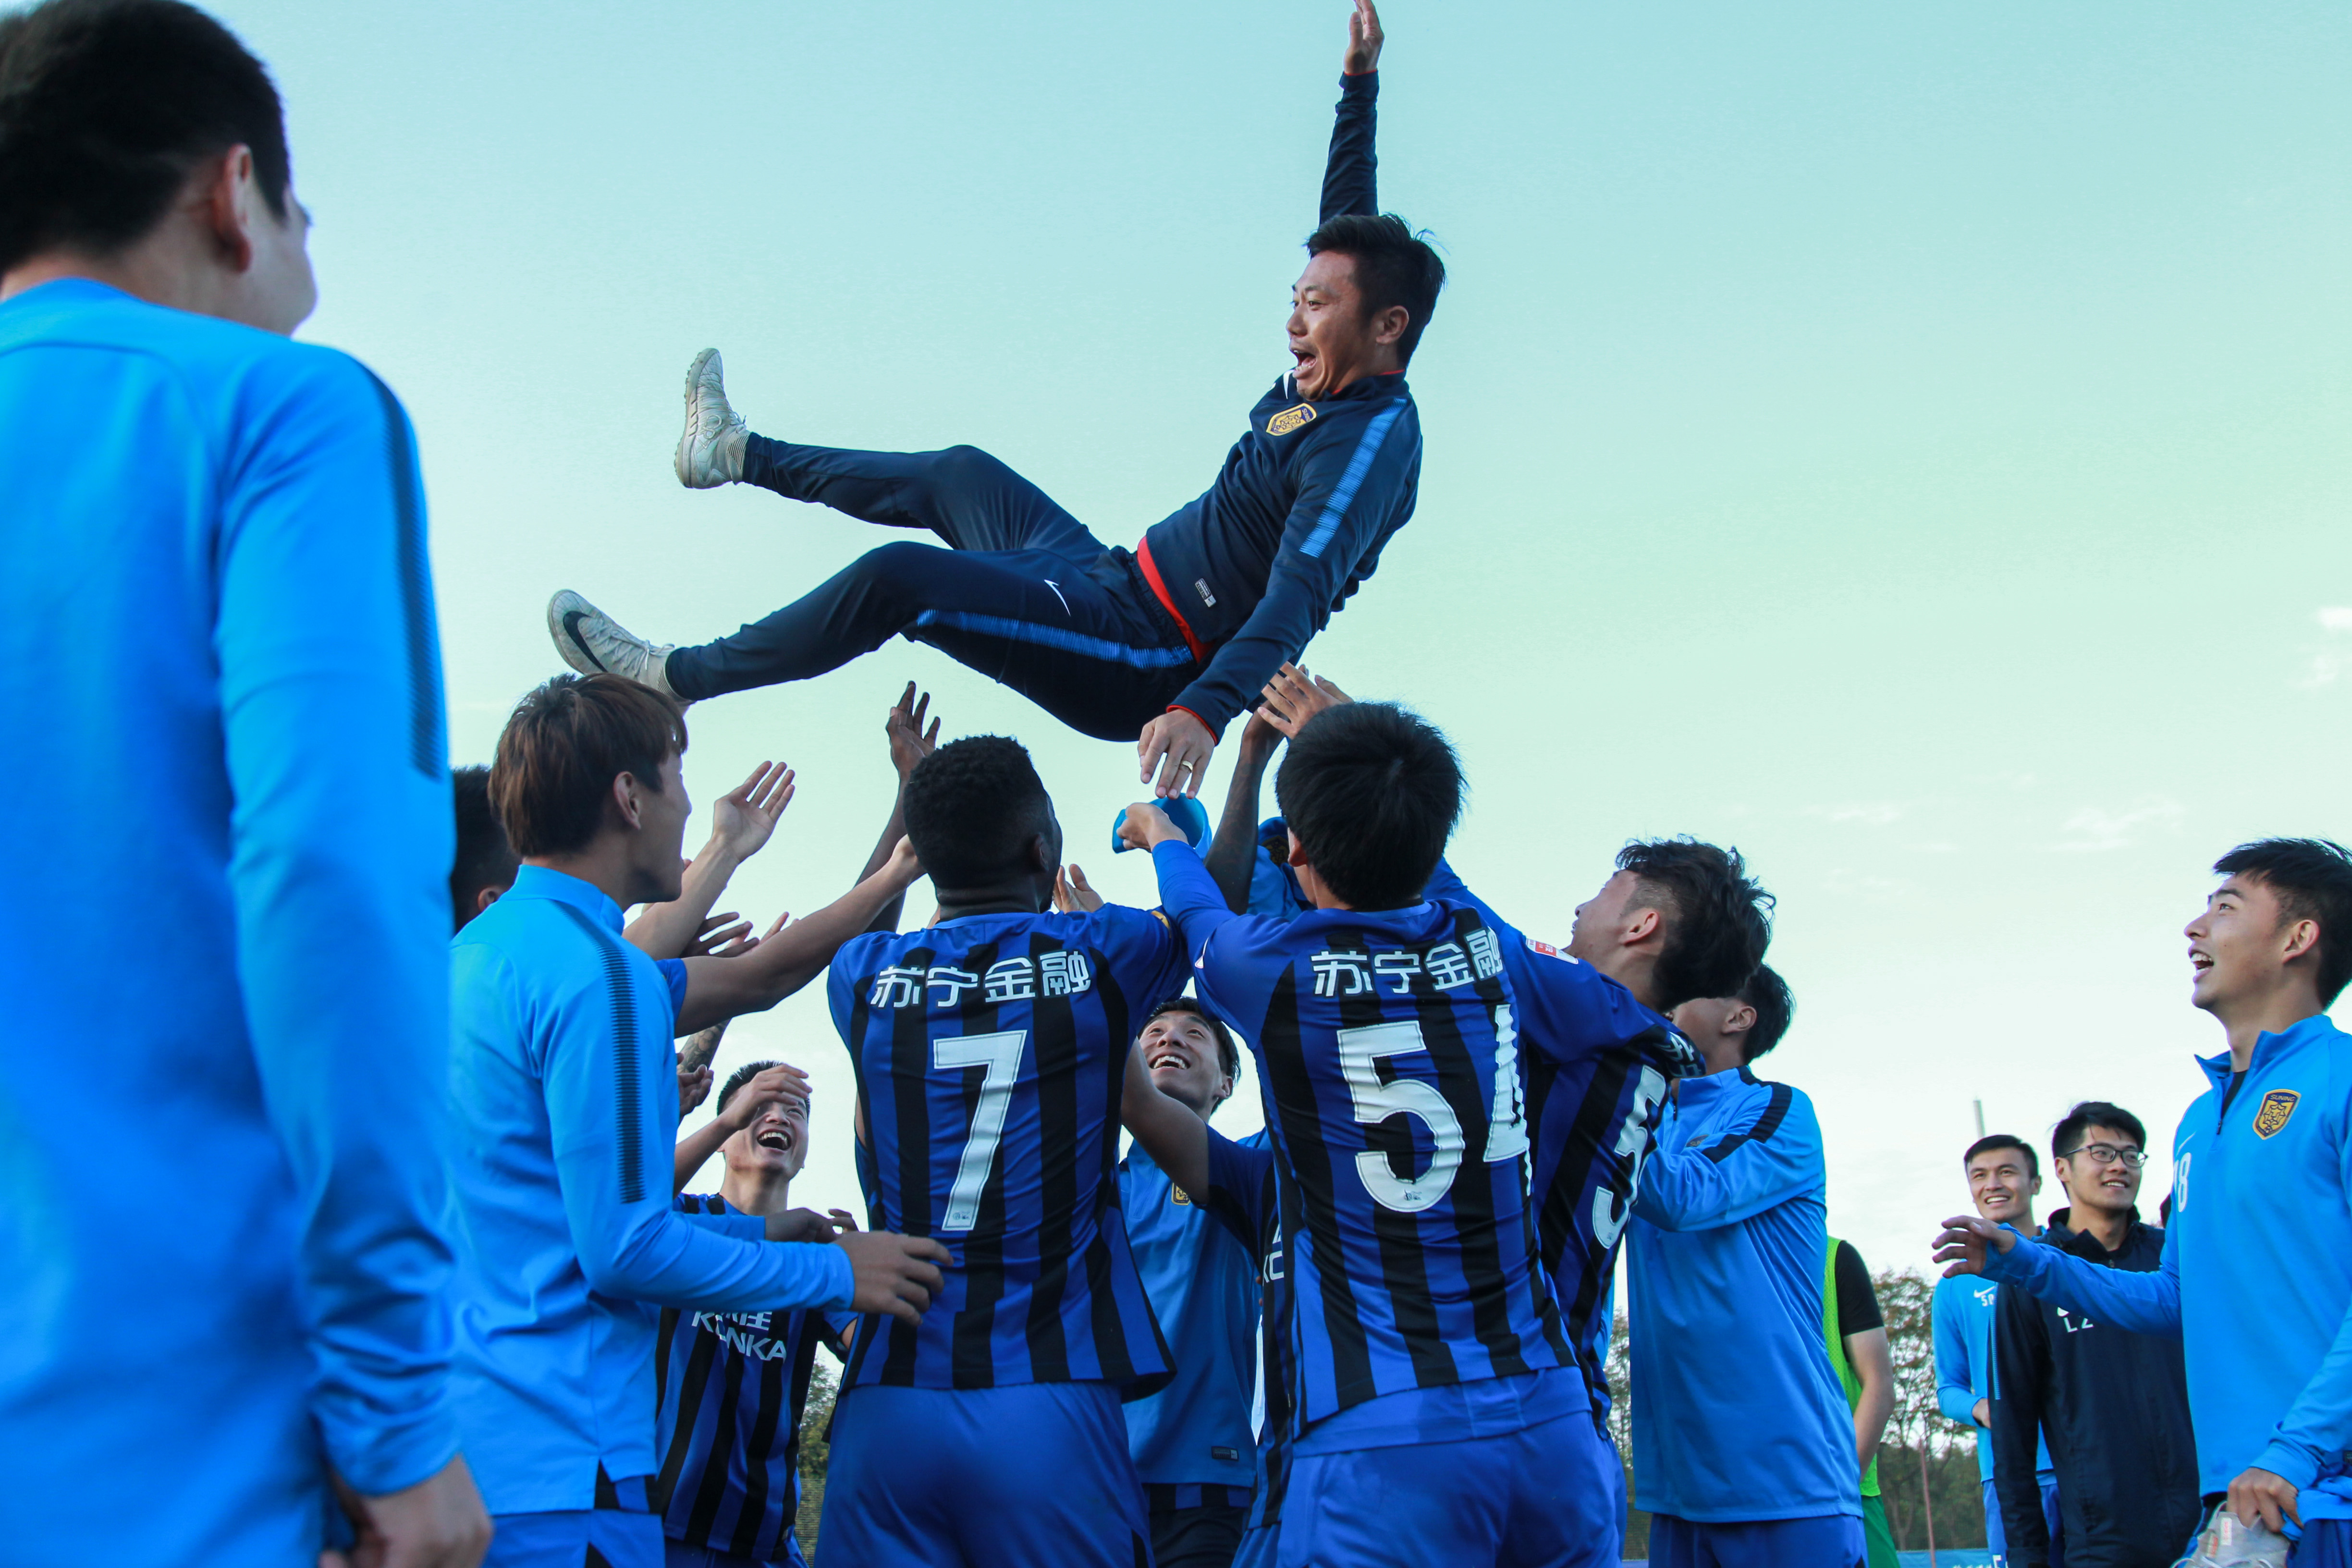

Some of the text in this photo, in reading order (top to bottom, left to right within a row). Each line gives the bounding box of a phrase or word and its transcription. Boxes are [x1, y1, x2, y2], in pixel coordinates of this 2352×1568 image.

[870, 951, 1091, 1008] 苏宁金融
[1311, 926, 1504, 997] 苏宁金融
[933, 1029, 1028, 1231] 7
[1336, 1004, 1532, 1213] 54
